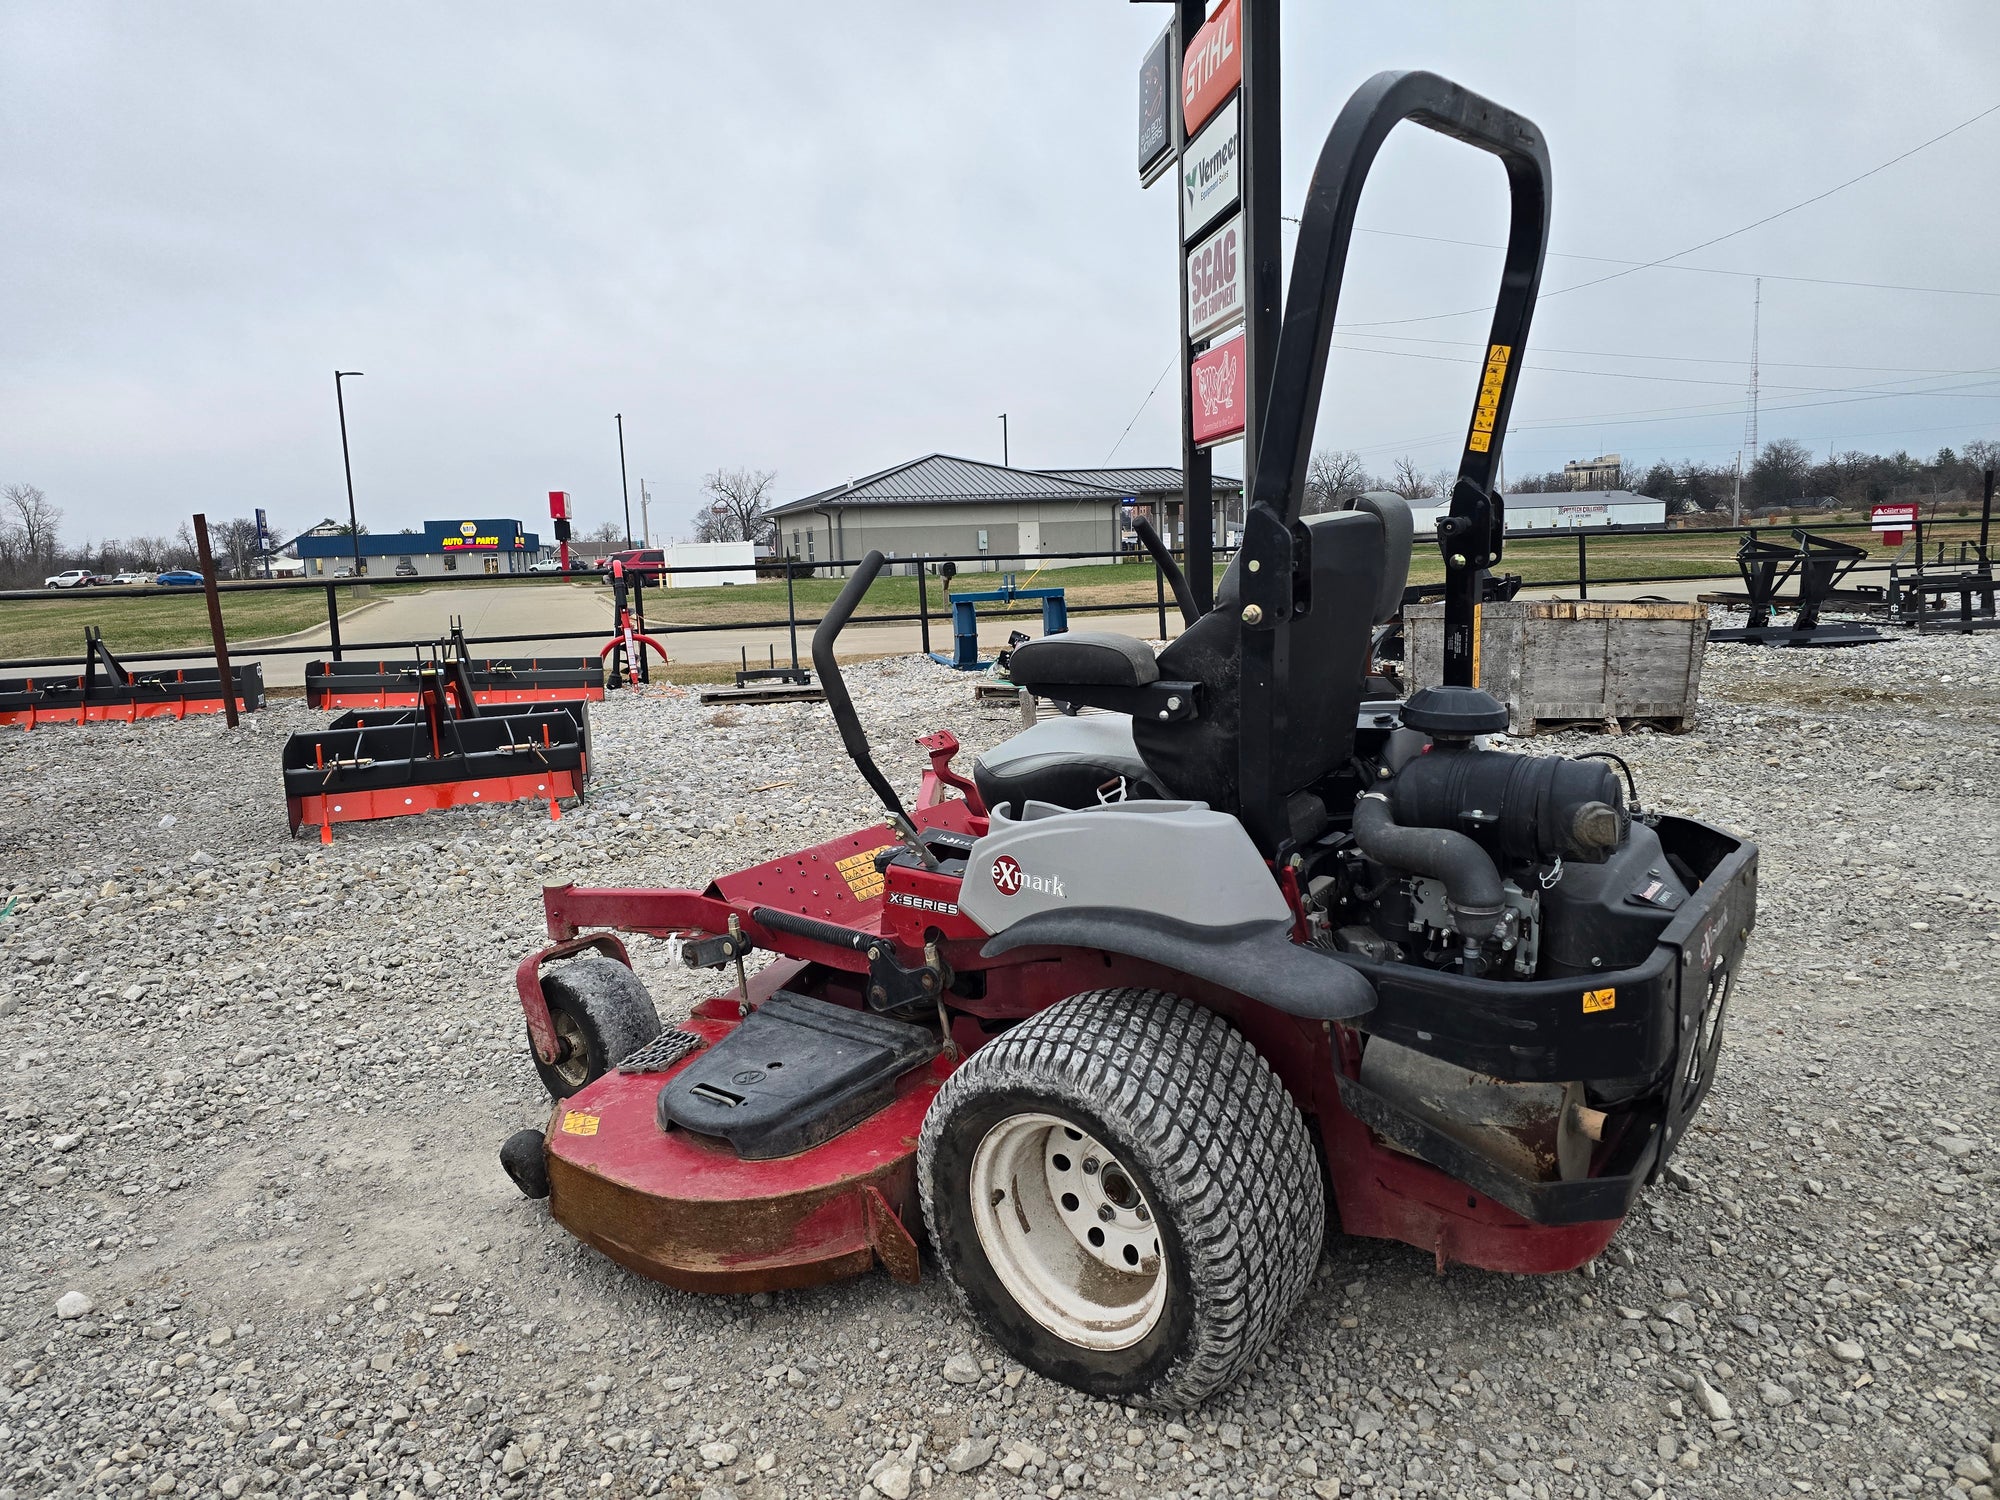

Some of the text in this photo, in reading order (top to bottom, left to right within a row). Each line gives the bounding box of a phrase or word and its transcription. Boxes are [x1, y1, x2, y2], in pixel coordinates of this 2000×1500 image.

[1186, 17, 1233, 107] STIHL
[1151, 114, 1162, 134] BOY
[1199, 134, 1237, 187] Vermeer
[1201, 178, 1218, 201] Equipment
[1192, 228, 1236, 305] SCAG
[1192, 282, 1237, 327] POWER EQUIPMENT
[476, 536, 499, 545] PARTS
